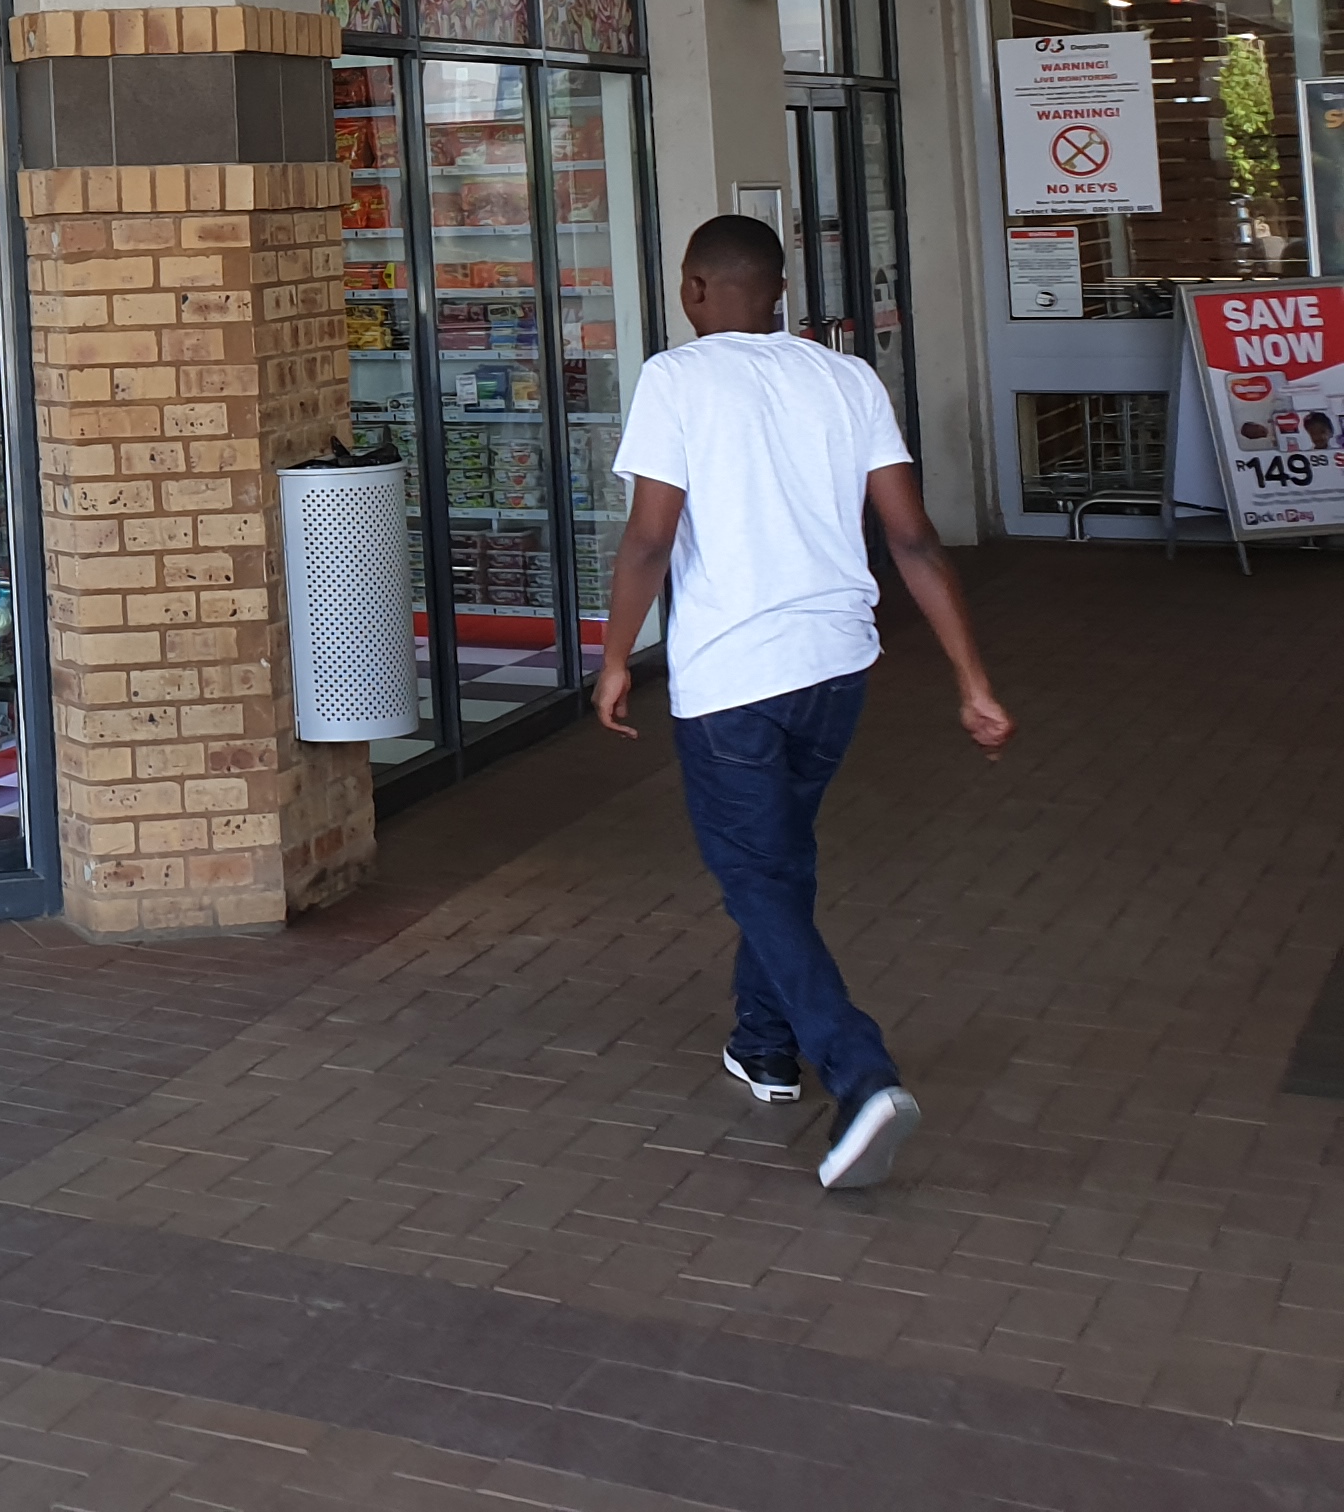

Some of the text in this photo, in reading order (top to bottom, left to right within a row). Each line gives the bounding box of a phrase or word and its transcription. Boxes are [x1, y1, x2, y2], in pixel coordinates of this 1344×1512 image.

[1041, 60, 1109, 72] WARNING!
[1036, 107, 1121, 121] WARNING!
[1046, 182, 1118, 194] NO KEYS
[1222, 295, 1325, 332] SAVE
[1234, 331, 1325, 368] NOW
